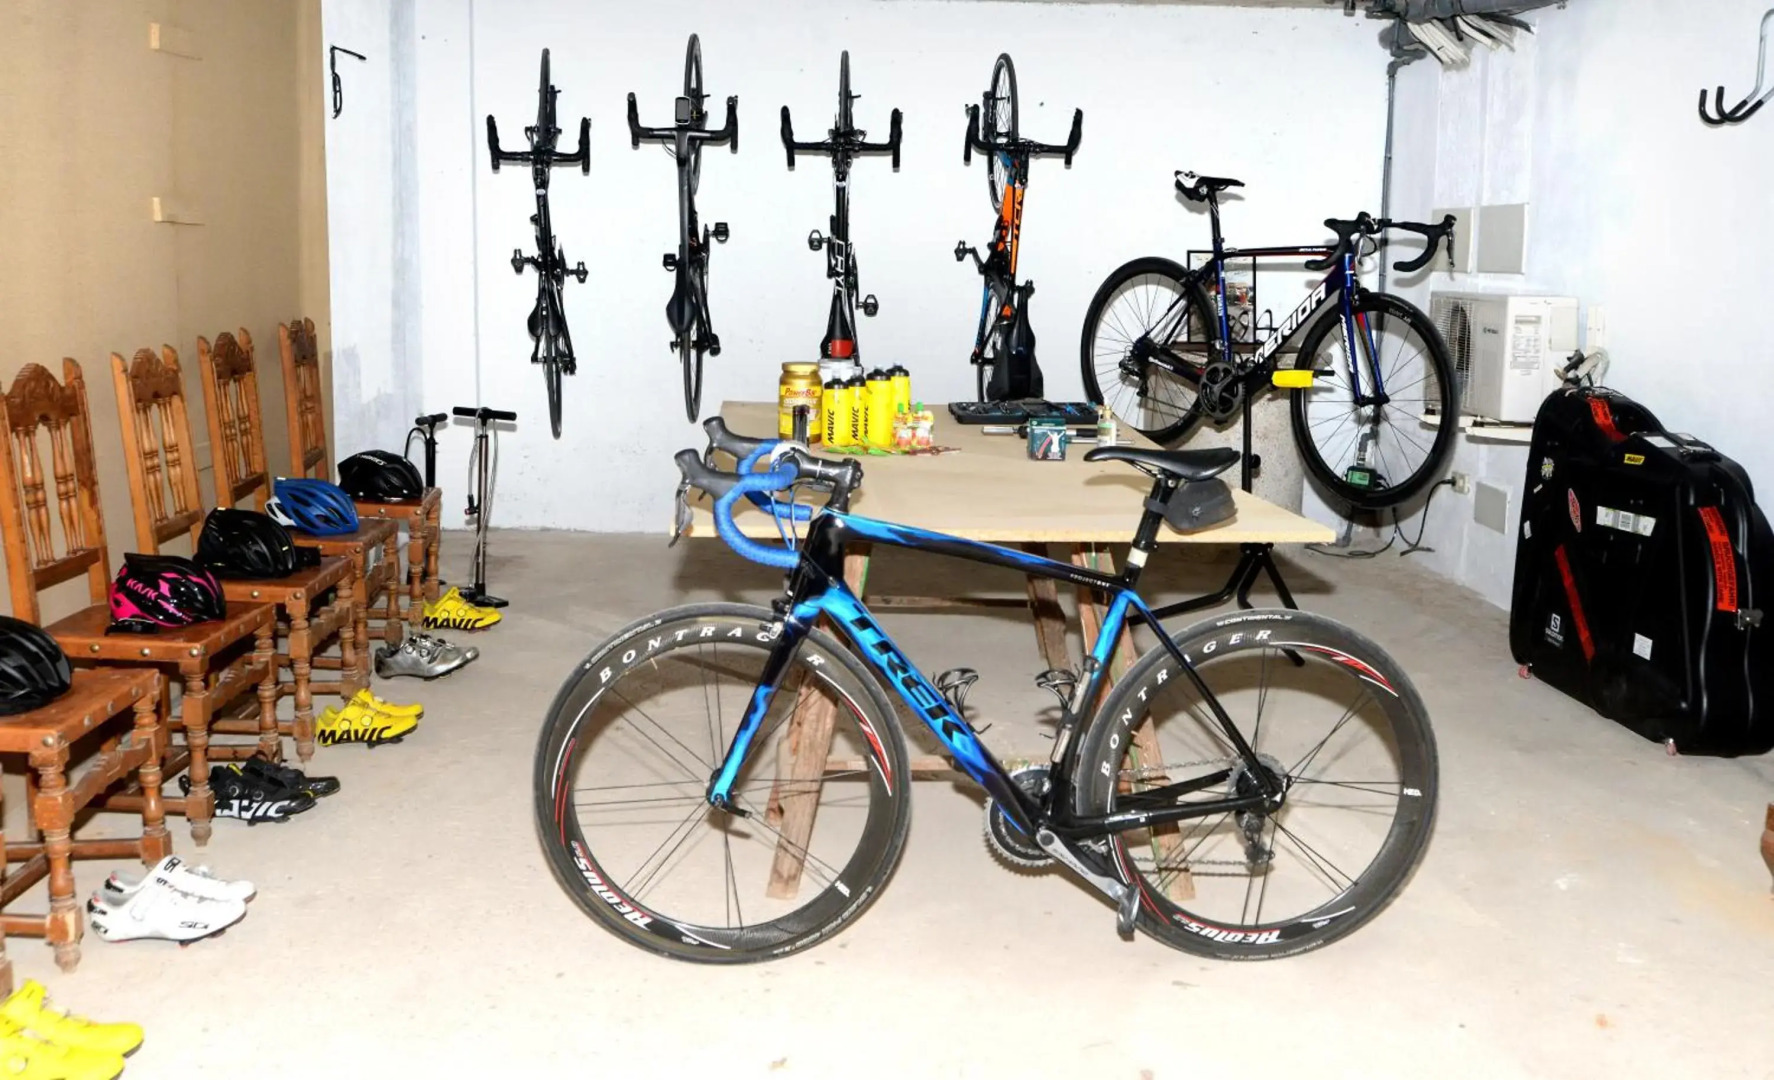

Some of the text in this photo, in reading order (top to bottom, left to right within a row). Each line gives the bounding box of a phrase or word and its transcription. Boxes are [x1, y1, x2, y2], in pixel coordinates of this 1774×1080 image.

[827, 408, 836, 444] MAVIC
[851, 406, 860, 441] MAVIC
[422, 616, 485, 630] MAVIC
[850, 602, 970, 744] TREK
[1101, 629, 1272, 777] BONTRGER
[317, 725, 393, 745] MAVIC
[1184, 922, 1284, 945] AEOLUS
